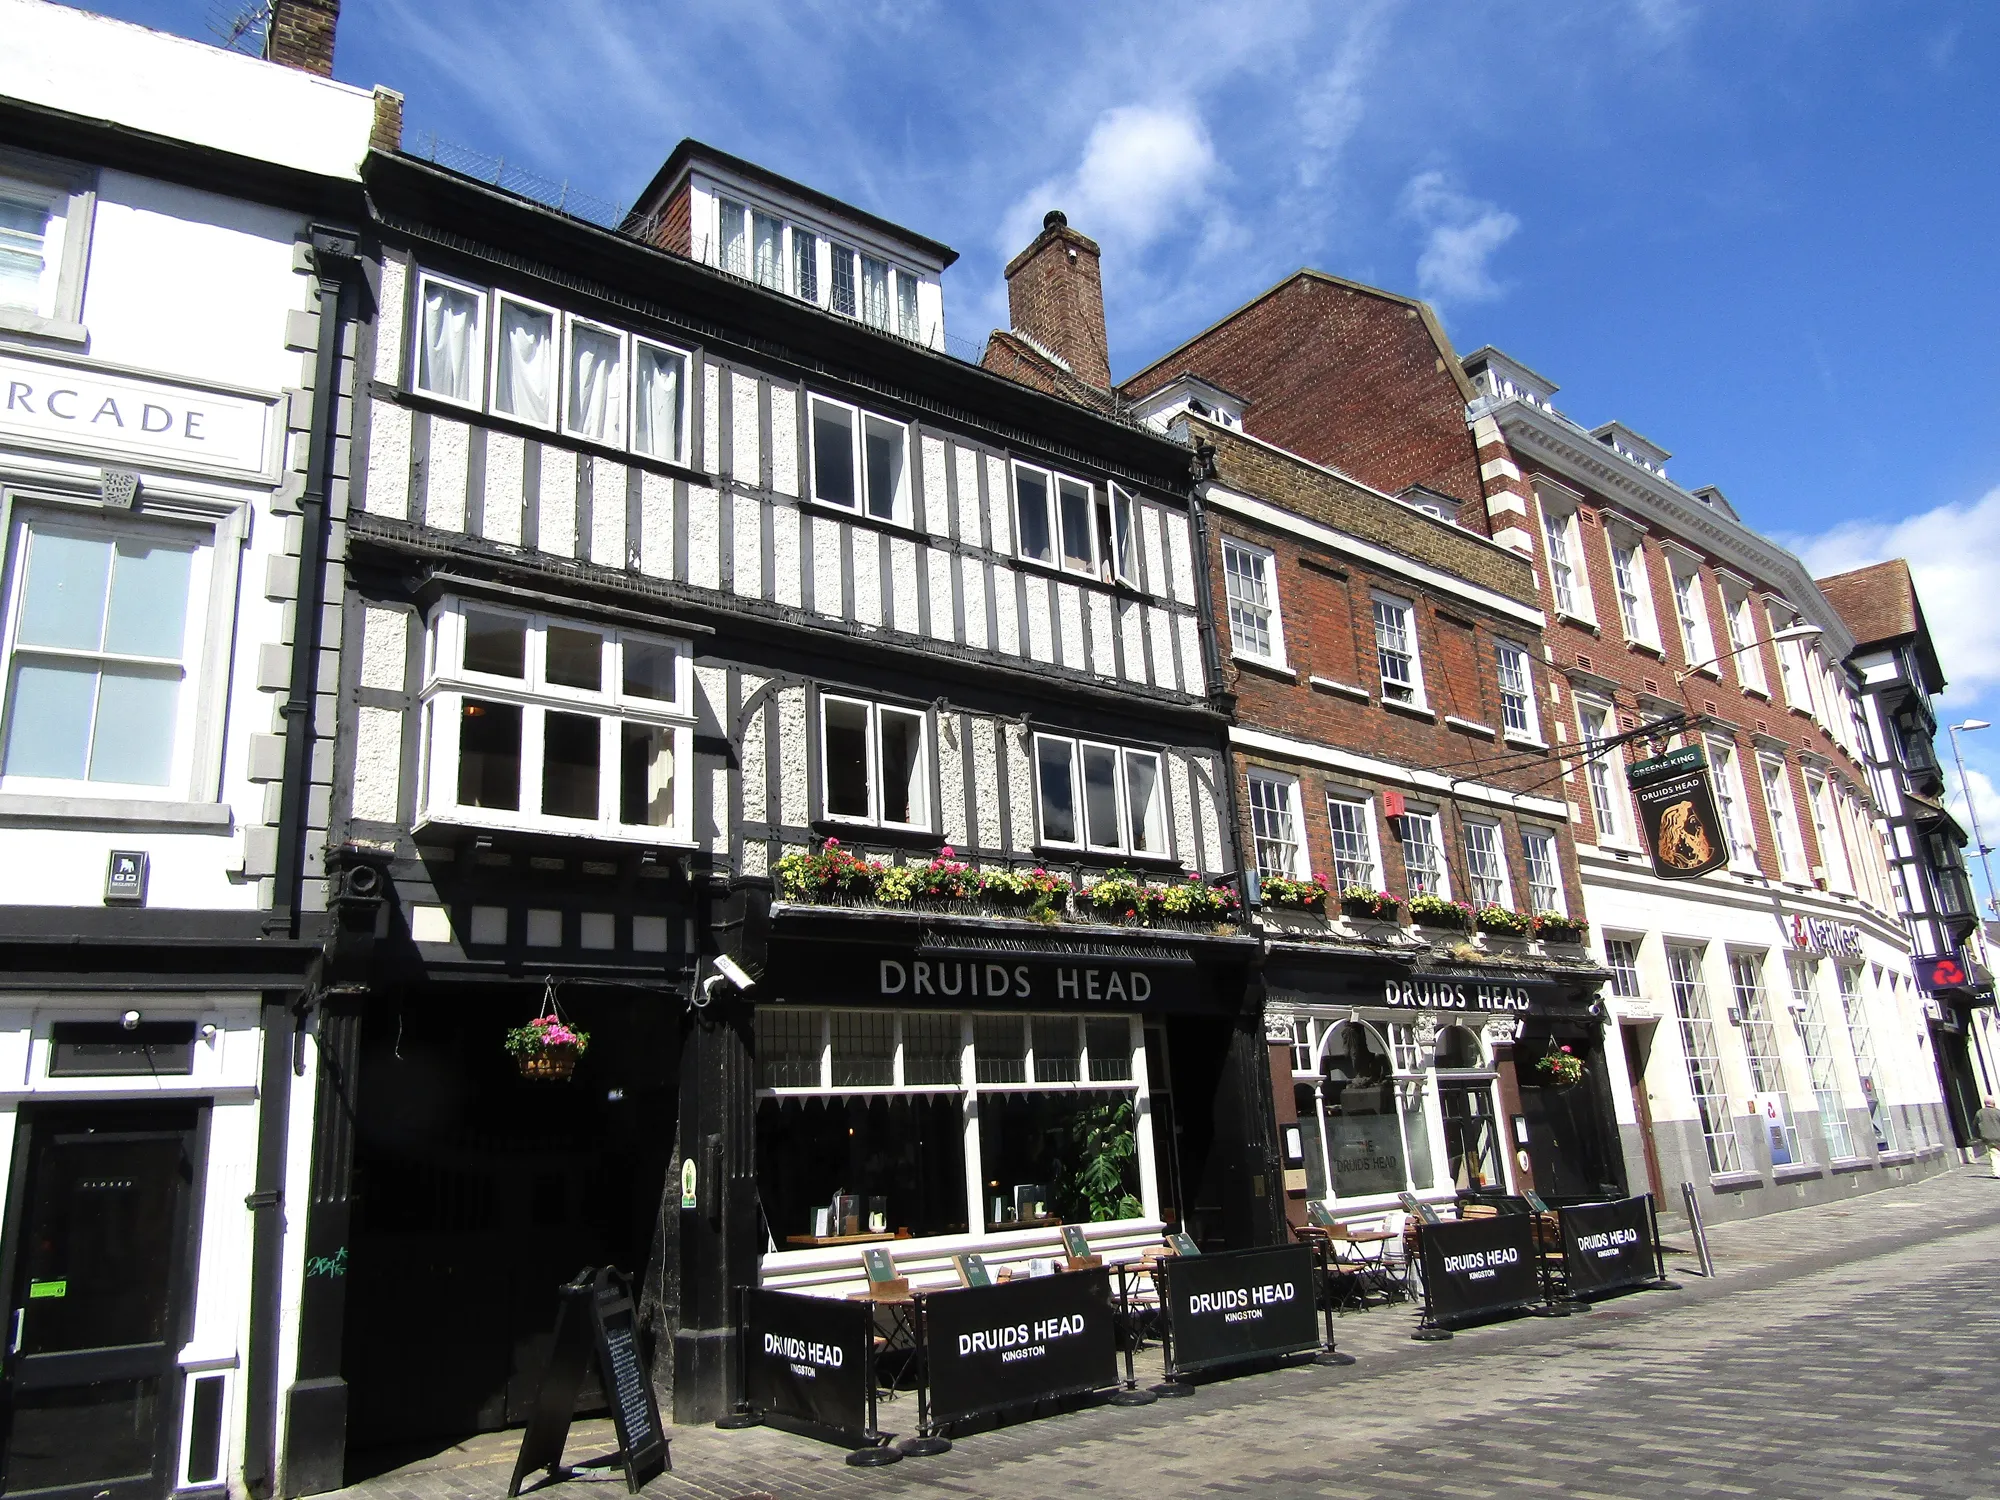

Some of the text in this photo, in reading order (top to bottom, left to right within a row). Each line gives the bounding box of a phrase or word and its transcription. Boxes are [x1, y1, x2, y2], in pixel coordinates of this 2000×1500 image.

[1632, 753, 1695, 777] GREENE KING
[1641, 786, 1673, 801] DRUIDS
[1674, 779, 1699, 793] HEAD
[114, 873, 137, 881] GD
[1804, 915, 1863, 956] NatWest
[880, 959, 1151, 1001] DRUIDS HEAD
[1385, 980, 1529, 1010] DRUIDS HEAD
[1356, 1140, 1374, 1153] THE
[1335, 1156, 1396, 1172] DRUIDS HEAD
[1577, 1228, 1637, 1251] DRUIDS HEAD
[1444, 1247, 1518, 1272] DRUIDS HEAD
[1597, 1247, 1619, 1258] KINGSTON
[1469, 1269, 1495, 1280] KINGSTON
[1189, 1282, 1294, 1314] DRUIDS HEAD
[1225, 1309, 1262, 1322] KINGSTON
[958, 1314, 1085, 1355] DRUIDS HEAD
[764, 1333, 843, 1367] DRUIDS HEAD
[1002, 1345, 1045, 1362] KINGSTON
